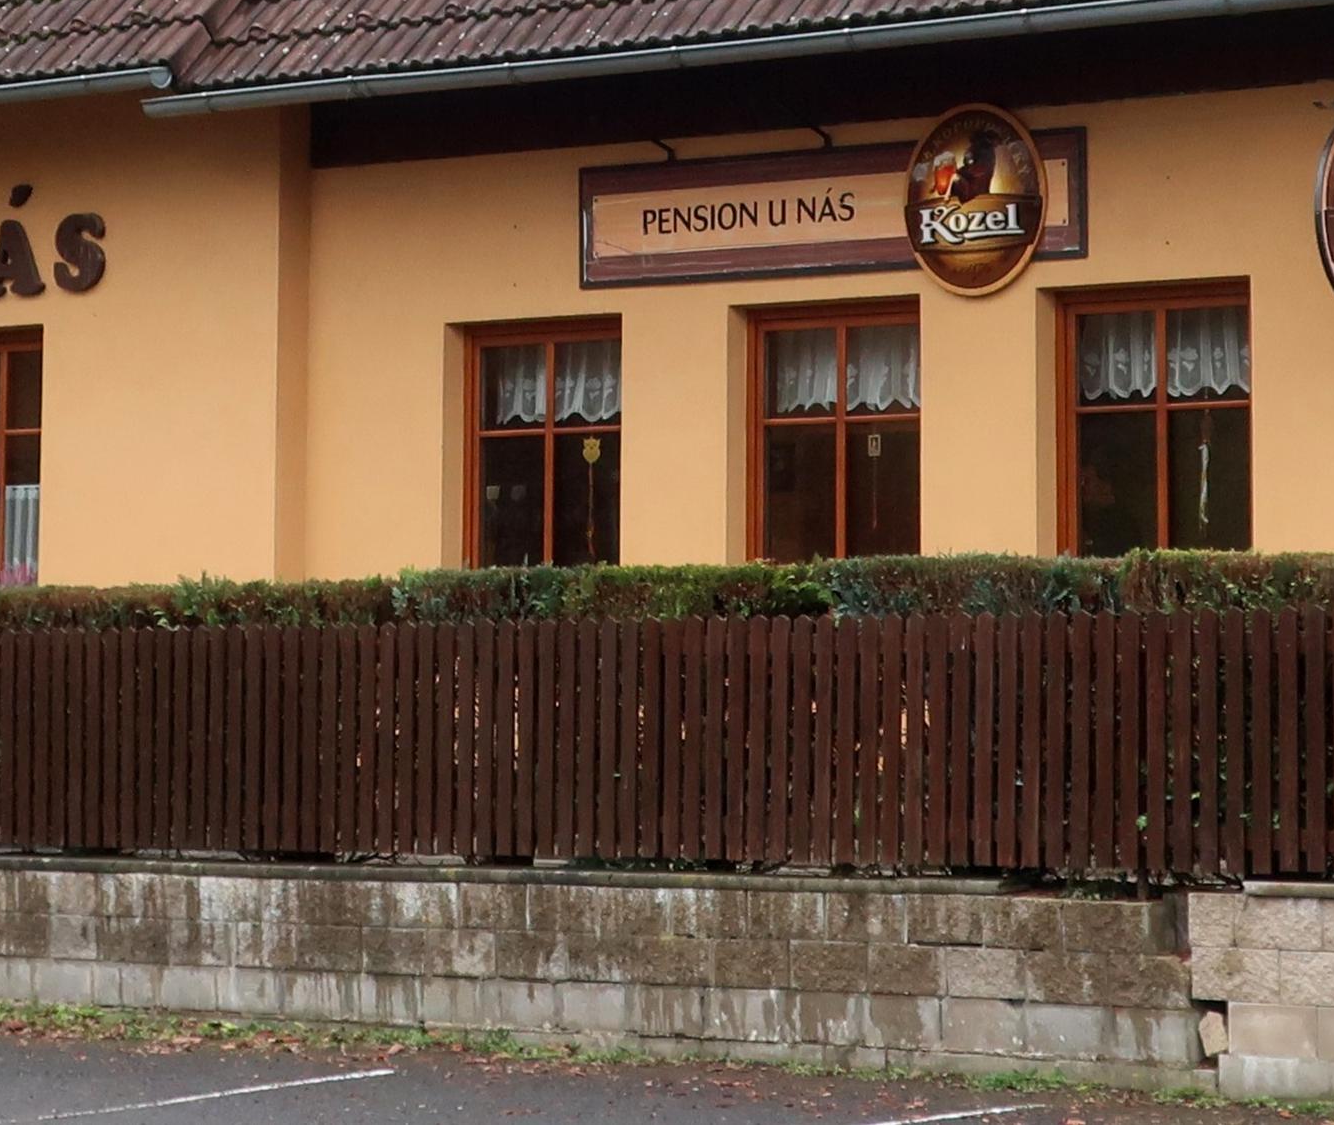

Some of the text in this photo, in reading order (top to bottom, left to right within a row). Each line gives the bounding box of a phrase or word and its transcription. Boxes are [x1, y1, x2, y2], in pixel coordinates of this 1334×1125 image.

[642, 186, 856, 236] PENSION U NÁS
[918, 202, 1026, 245] Kozel
